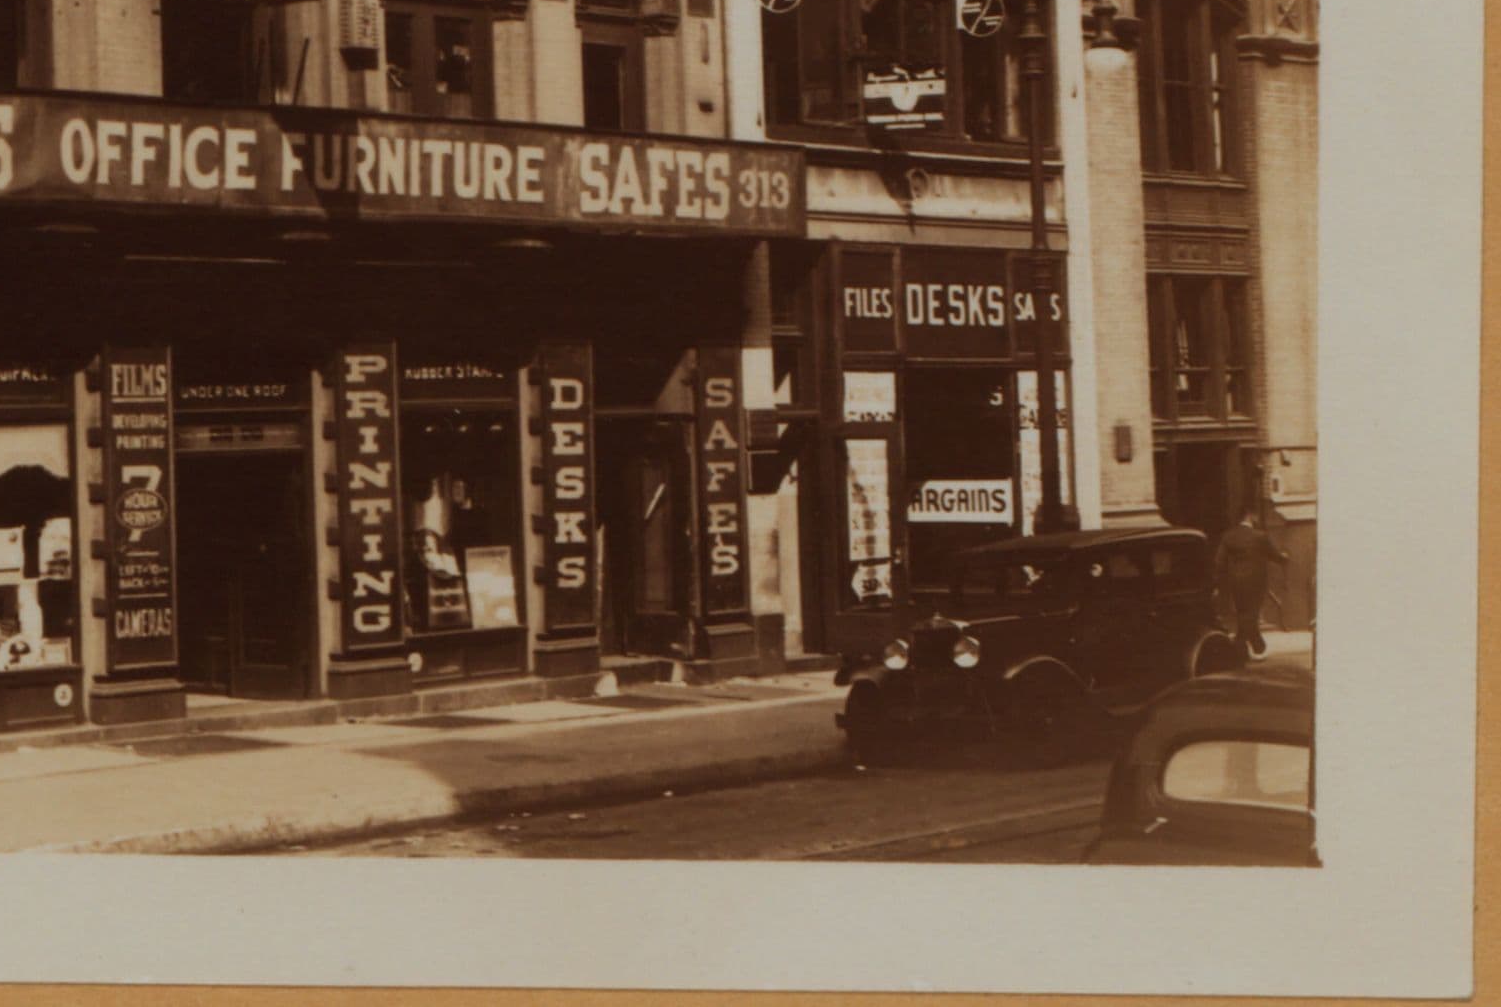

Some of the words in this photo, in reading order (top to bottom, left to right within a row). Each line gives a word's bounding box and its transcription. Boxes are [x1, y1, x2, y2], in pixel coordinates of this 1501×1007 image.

[61, 119, 258, 191] OFFICE
[282, 130, 545, 203] FURNITURE
[580, 143, 731, 220] SAFES
[739, 170, 791, 210] 313
[844, 286, 893, 320] FILES
[906, 283, 1005, 328] DESKS
[1014, 293, 1062, 322] SAS
[110, 362, 167, 397] FILMS
[344, 354, 394, 634] PRINTING
[549, 377, 587, 590] DESKS
[704, 378, 739, 576] SAFES
[123, 492, 159, 509] HOUR
[909, 488, 1007, 514] ARGAINS
[115, 608, 173, 639] CAMERAS
